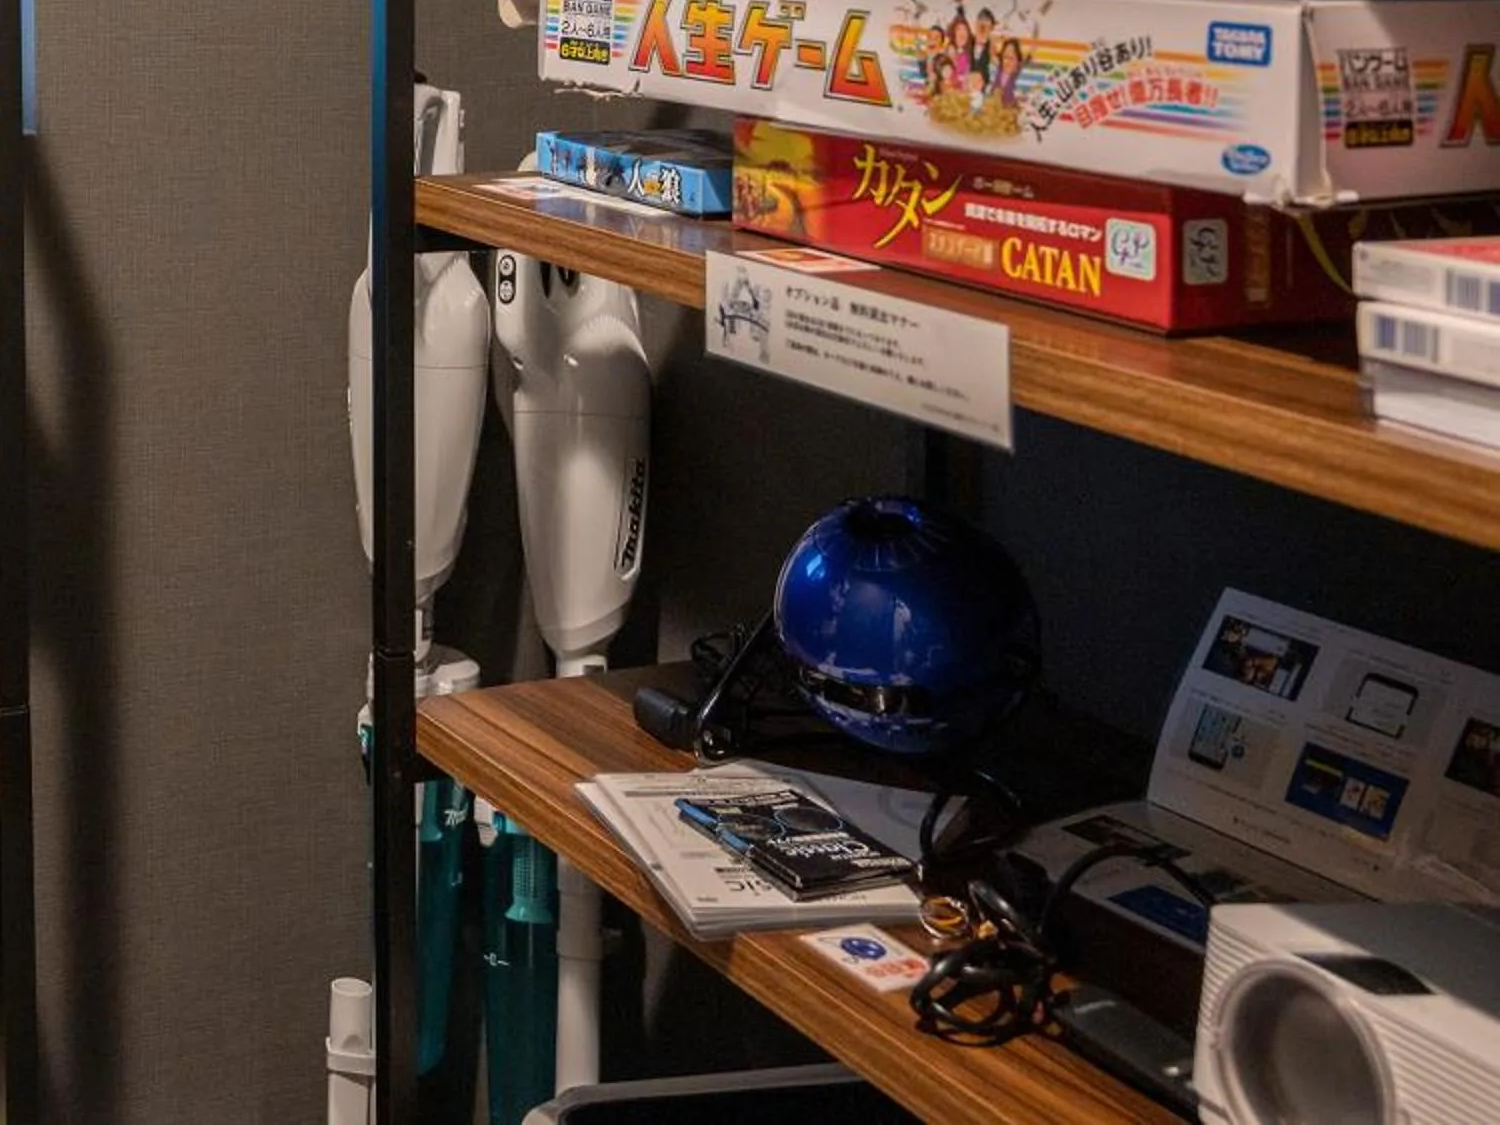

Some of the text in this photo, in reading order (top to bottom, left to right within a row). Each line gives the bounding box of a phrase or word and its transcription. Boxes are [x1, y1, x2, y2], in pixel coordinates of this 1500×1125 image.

[1214, 43, 1264, 61] TOMY
[1438, 43, 1500, 149] 人
[852, 142, 964, 250] カタン
[1000, 235, 1102, 297] CATAN
